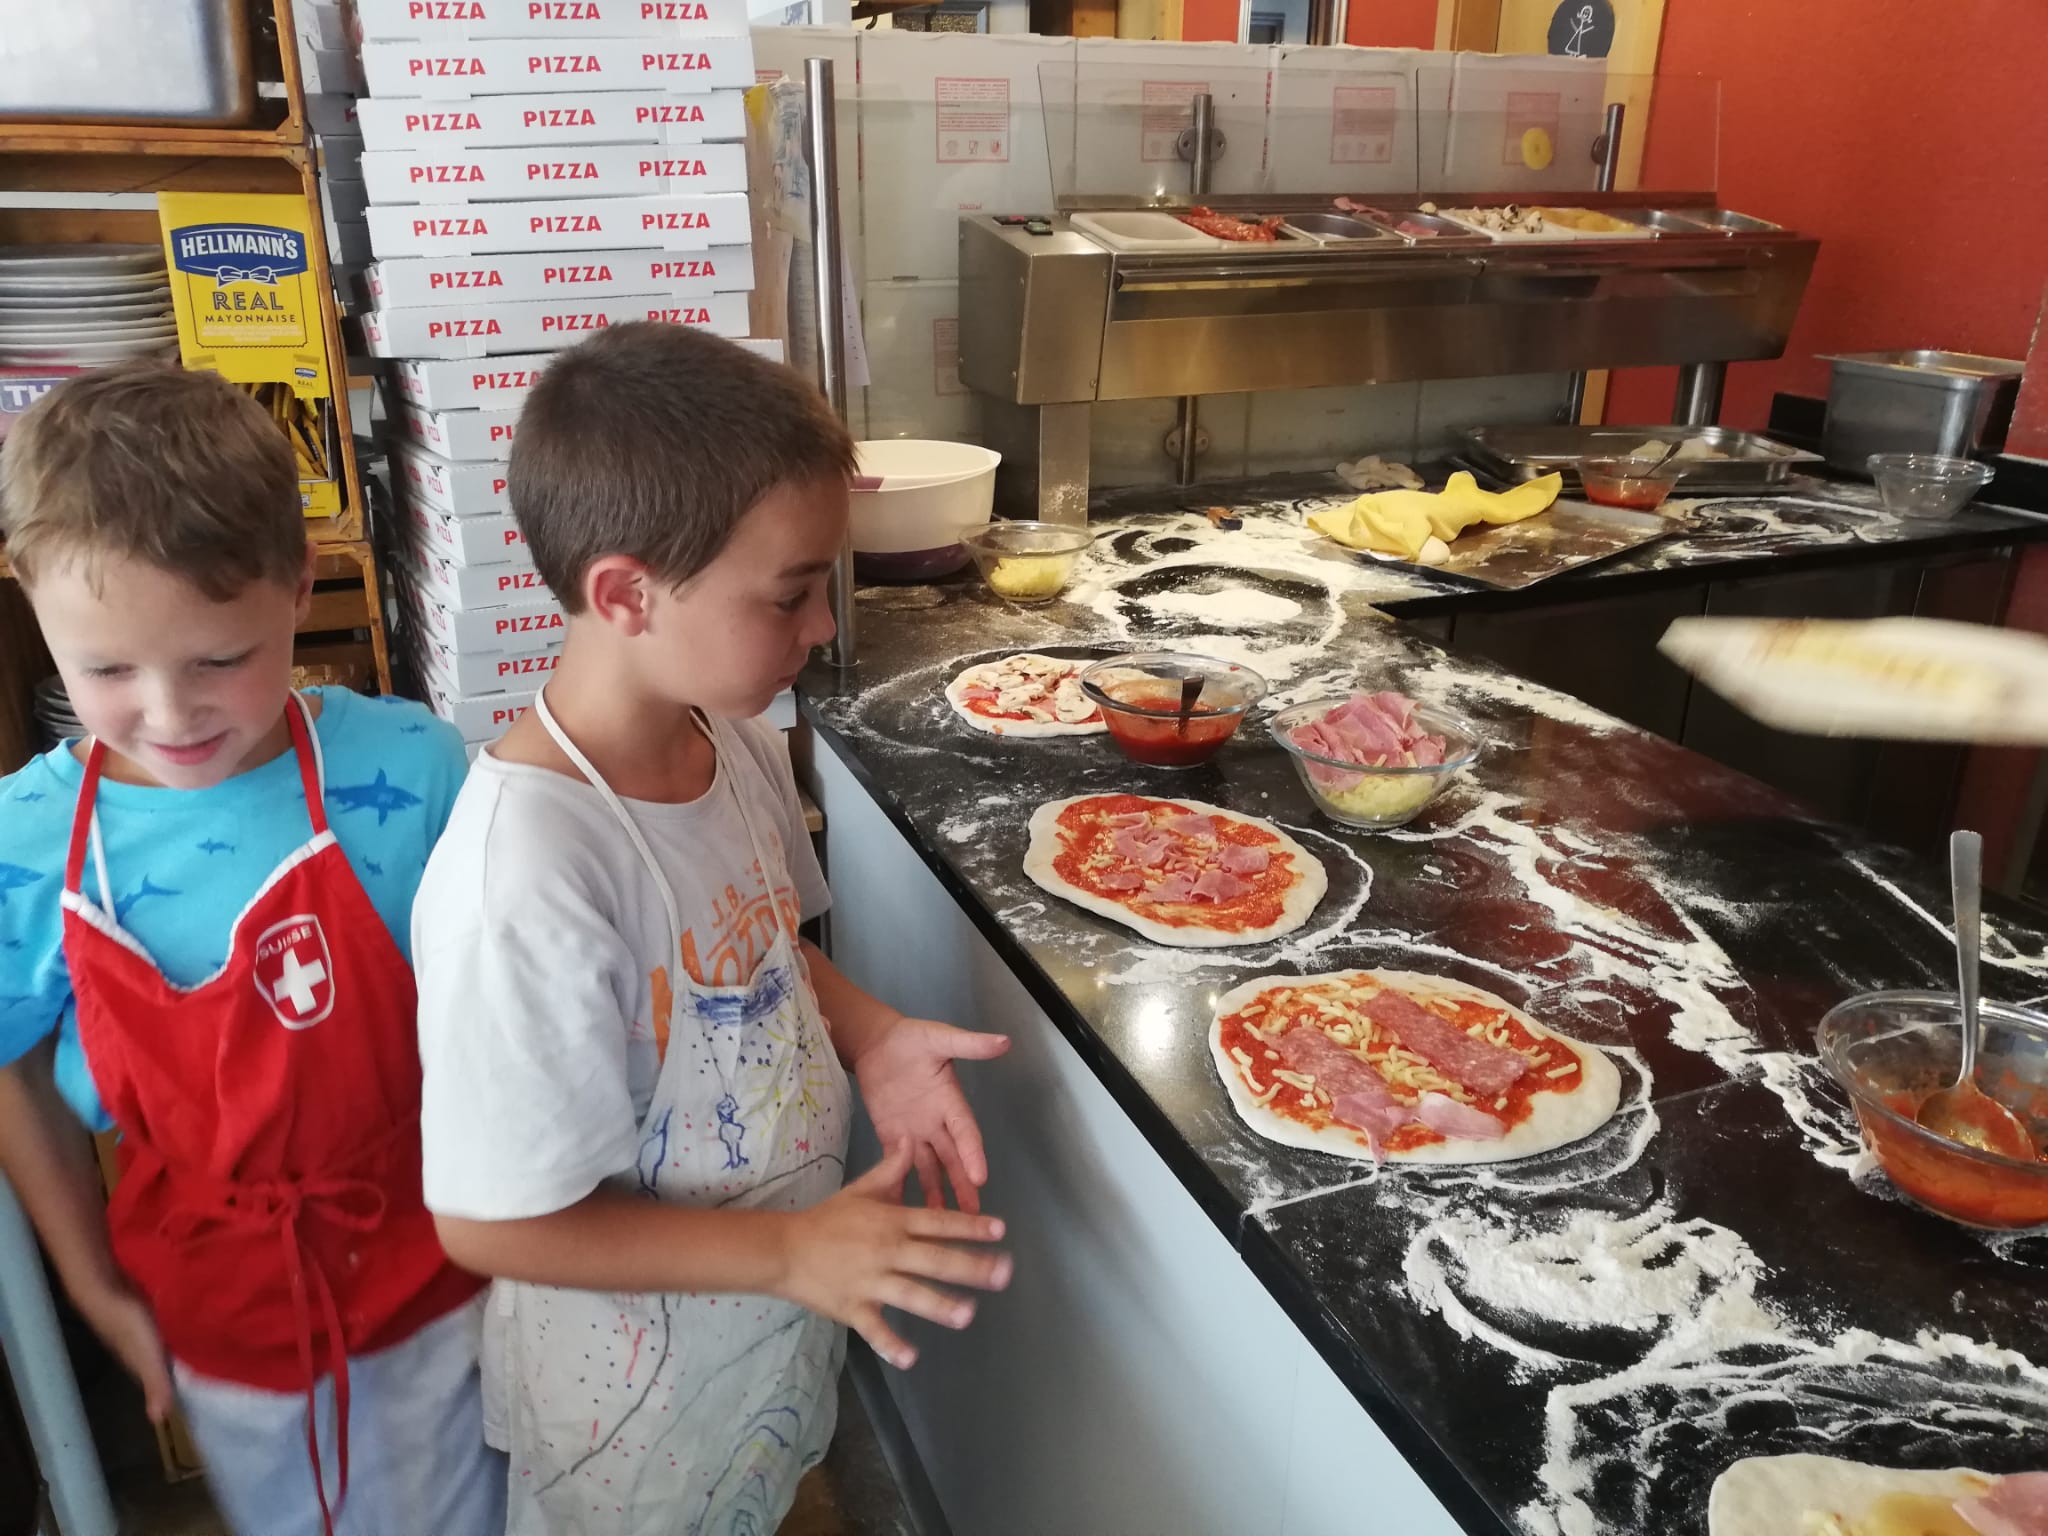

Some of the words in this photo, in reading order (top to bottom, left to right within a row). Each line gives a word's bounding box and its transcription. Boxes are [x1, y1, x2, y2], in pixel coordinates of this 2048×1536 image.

[410, 2, 485, 19] PIZZA
[529, 3, 600, 20] PIZZA
[641, 3, 708, 20] PIZZA
[410, 58, 485, 76] PIZZA
[529, 56, 601, 73] PIZZA
[643, 53, 711, 71] PIZZA
[406, 113, 481, 131] PIZZA
[524, 109, 595, 127] PIZZA
[636, 106, 704, 123] PIZZA
[410, 165, 484, 183] PIZZA
[528, 162, 598, 180] PIZZA
[640, 160, 706, 177] PIZZA
[413, 219, 487, 236] PIZZA
[530, 215, 601, 233] PIZZA
[642, 212, 710, 229] PIZZA
[180, 233, 298, 259] HELLMANN'S
[430, 270, 502, 289] PIZZA
[544, 265, 612, 283] PIZZA
[651, 261, 715, 278] PIZZA
[212, 291, 284, 310] REAL
[205, 314, 296, 323] MAYONNAISE
[429, 319, 501, 338] PIZZA
[542, 313, 608, 332] PIZZA
[647, 308, 711, 324] PIZZA
[496, 613, 564, 635] PIZZA
